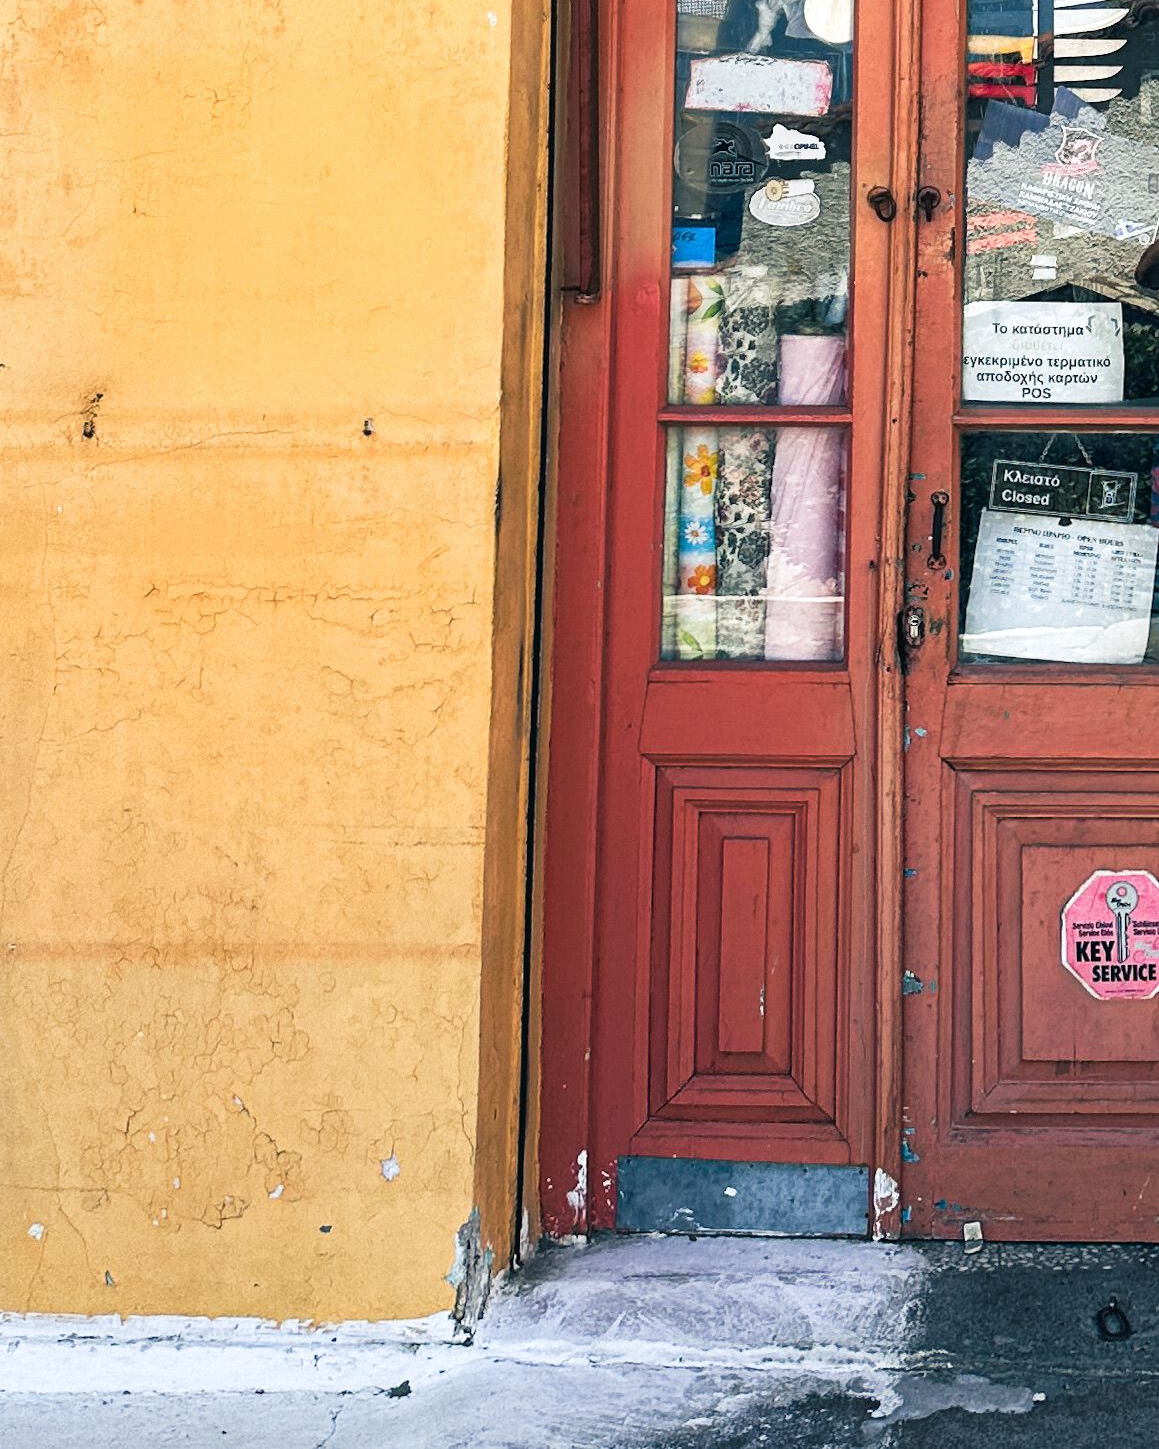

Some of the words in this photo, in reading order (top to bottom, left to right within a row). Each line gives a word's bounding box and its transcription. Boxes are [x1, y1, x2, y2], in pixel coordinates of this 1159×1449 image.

[992, 323, 1008, 334] Το
[1012, 323, 1084, 338] κατάστημα
[963, 355, 1043, 369] εγκεκριμένο
[1048, 356, 1111, 371] τερματικό
[976, 371, 1044, 385] αποδοχής
[1048, 372, 1098, 385] καρτών
[1022, 388, 1052, 399] POS
[1003, 469, 1060, 487] Κλειστό
[1001, 489, 1050, 506] Closed
[1076, 940, 1115, 962] KEY
[1092, 963, 1157, 982] SERVICE
